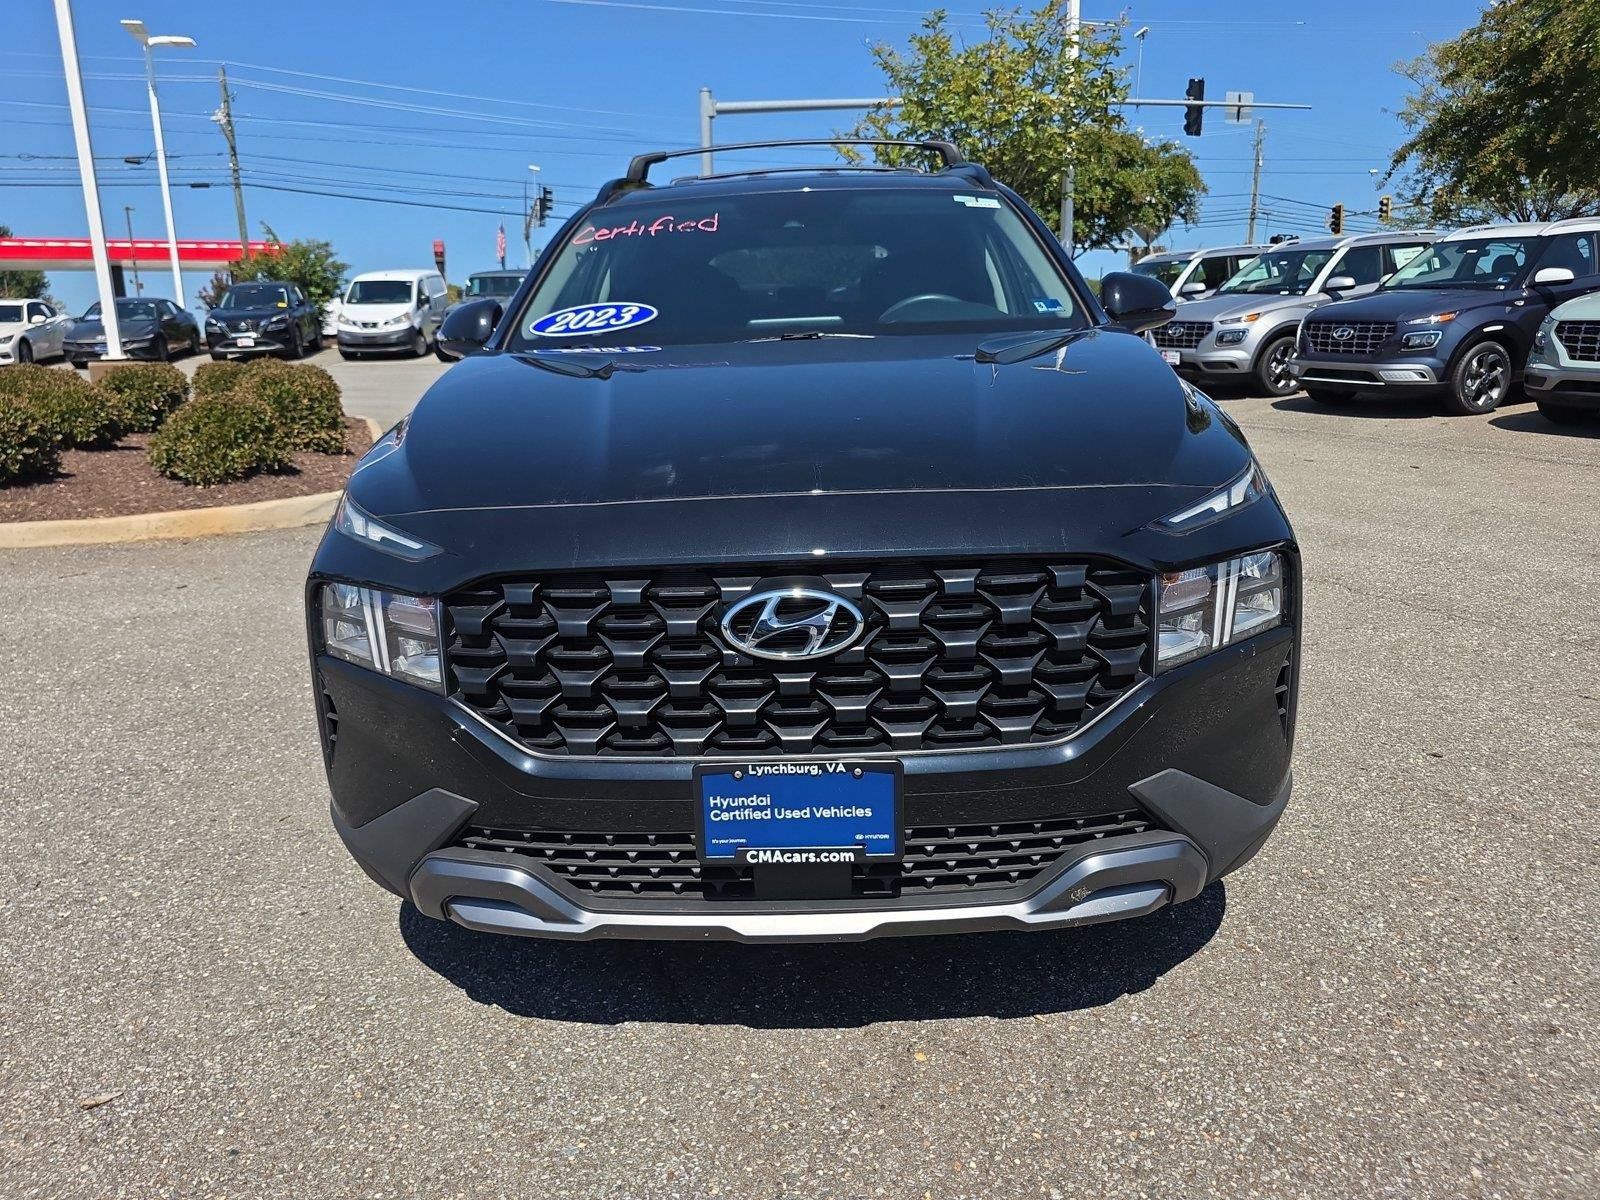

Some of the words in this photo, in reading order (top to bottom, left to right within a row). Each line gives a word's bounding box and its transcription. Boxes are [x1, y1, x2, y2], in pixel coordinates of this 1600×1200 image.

[571, 213, 719, 245] Certified
[544, 306, 641, 333] 2023
[748, 764, 822, 776] Lynchburg,
[826, 763, 846, 773] VA
[709, 794, 771, 809] Hyundai
[709, 808, 772, 821] Certified
[774, 807, 811, 819] Used
[812, 805, 873, 818] Vehicles
[746, 850, 855, 864] CMAcars.com
